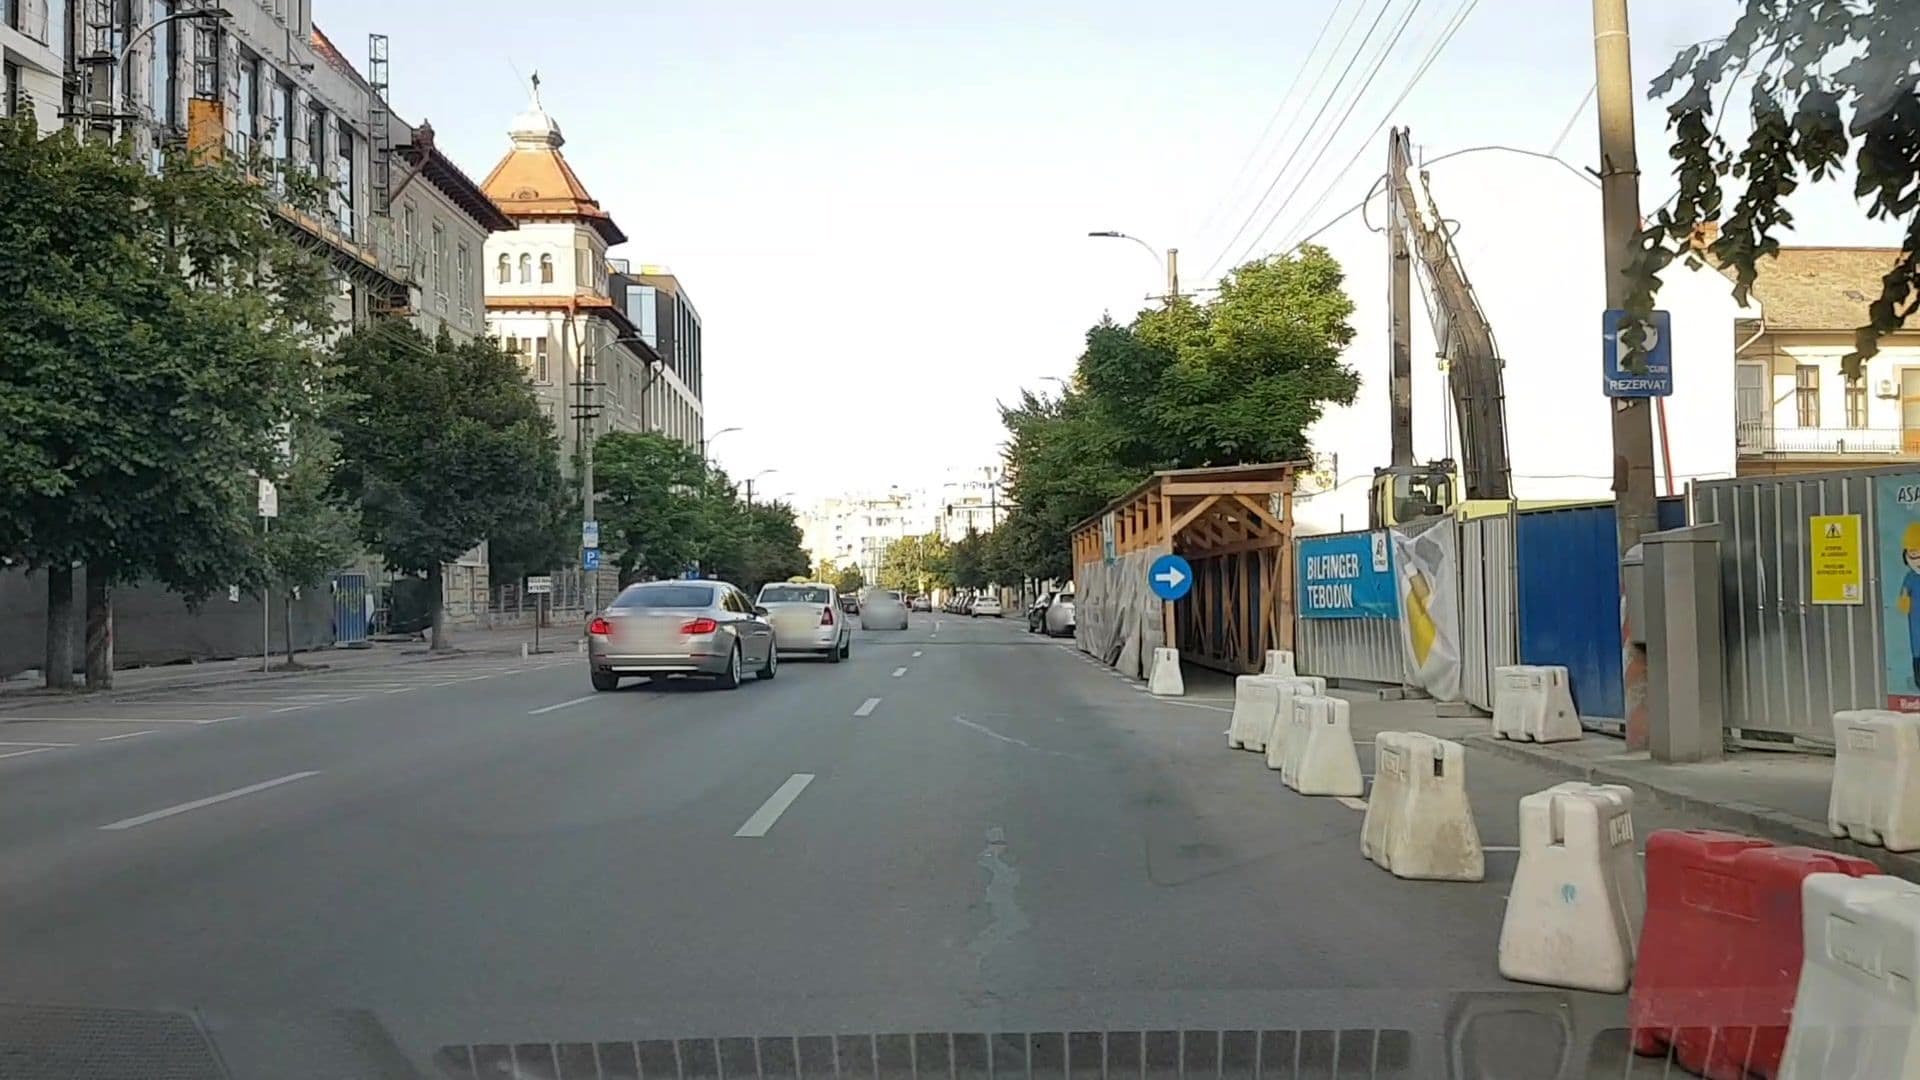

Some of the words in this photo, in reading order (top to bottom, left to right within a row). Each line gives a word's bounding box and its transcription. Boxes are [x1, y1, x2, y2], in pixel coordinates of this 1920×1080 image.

[1609, 380, 1667, 391] REZERVAT
[587, 552, 595, 563] P
[1307, 553, 1359, 580] BILFINGER
[1307, 584, 1353, 609] TEBODIN
